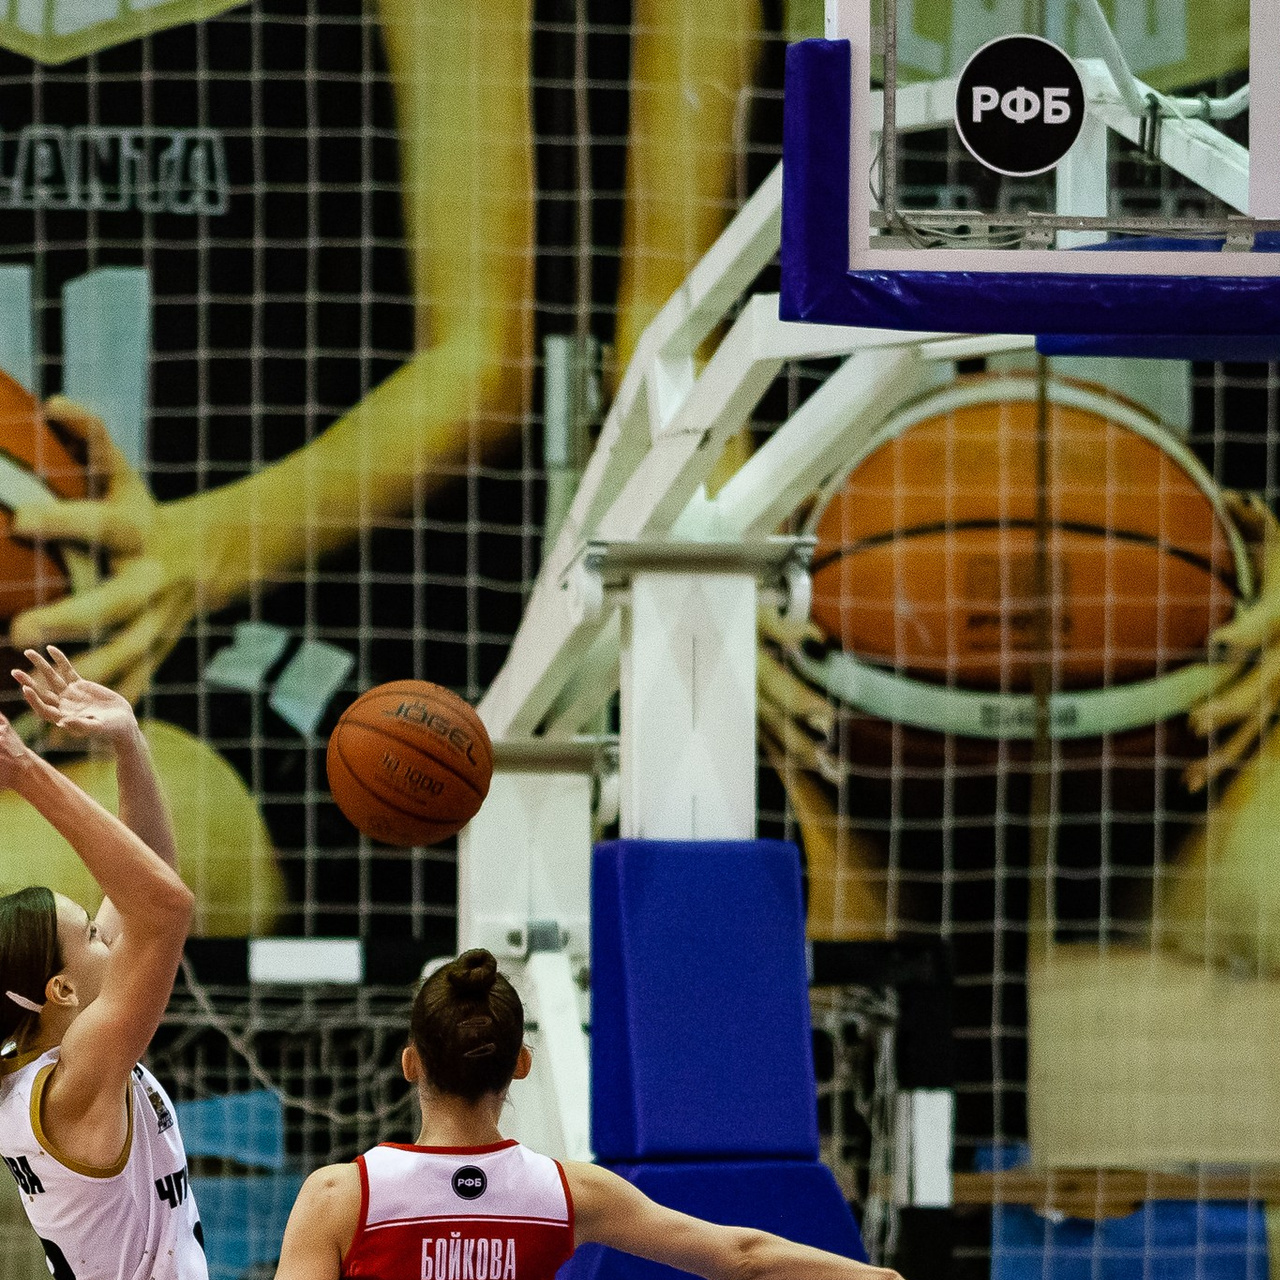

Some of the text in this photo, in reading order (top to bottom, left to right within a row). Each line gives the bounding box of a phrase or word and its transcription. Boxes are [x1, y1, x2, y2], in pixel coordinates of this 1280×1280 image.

[972, 86, 1071, 124] РФБ
[2, 1155, 46, 1195] ВА
[457, 1178, 482, 1188] РФБ
[420, 1231, 516, 1280] БОЙКОВА
